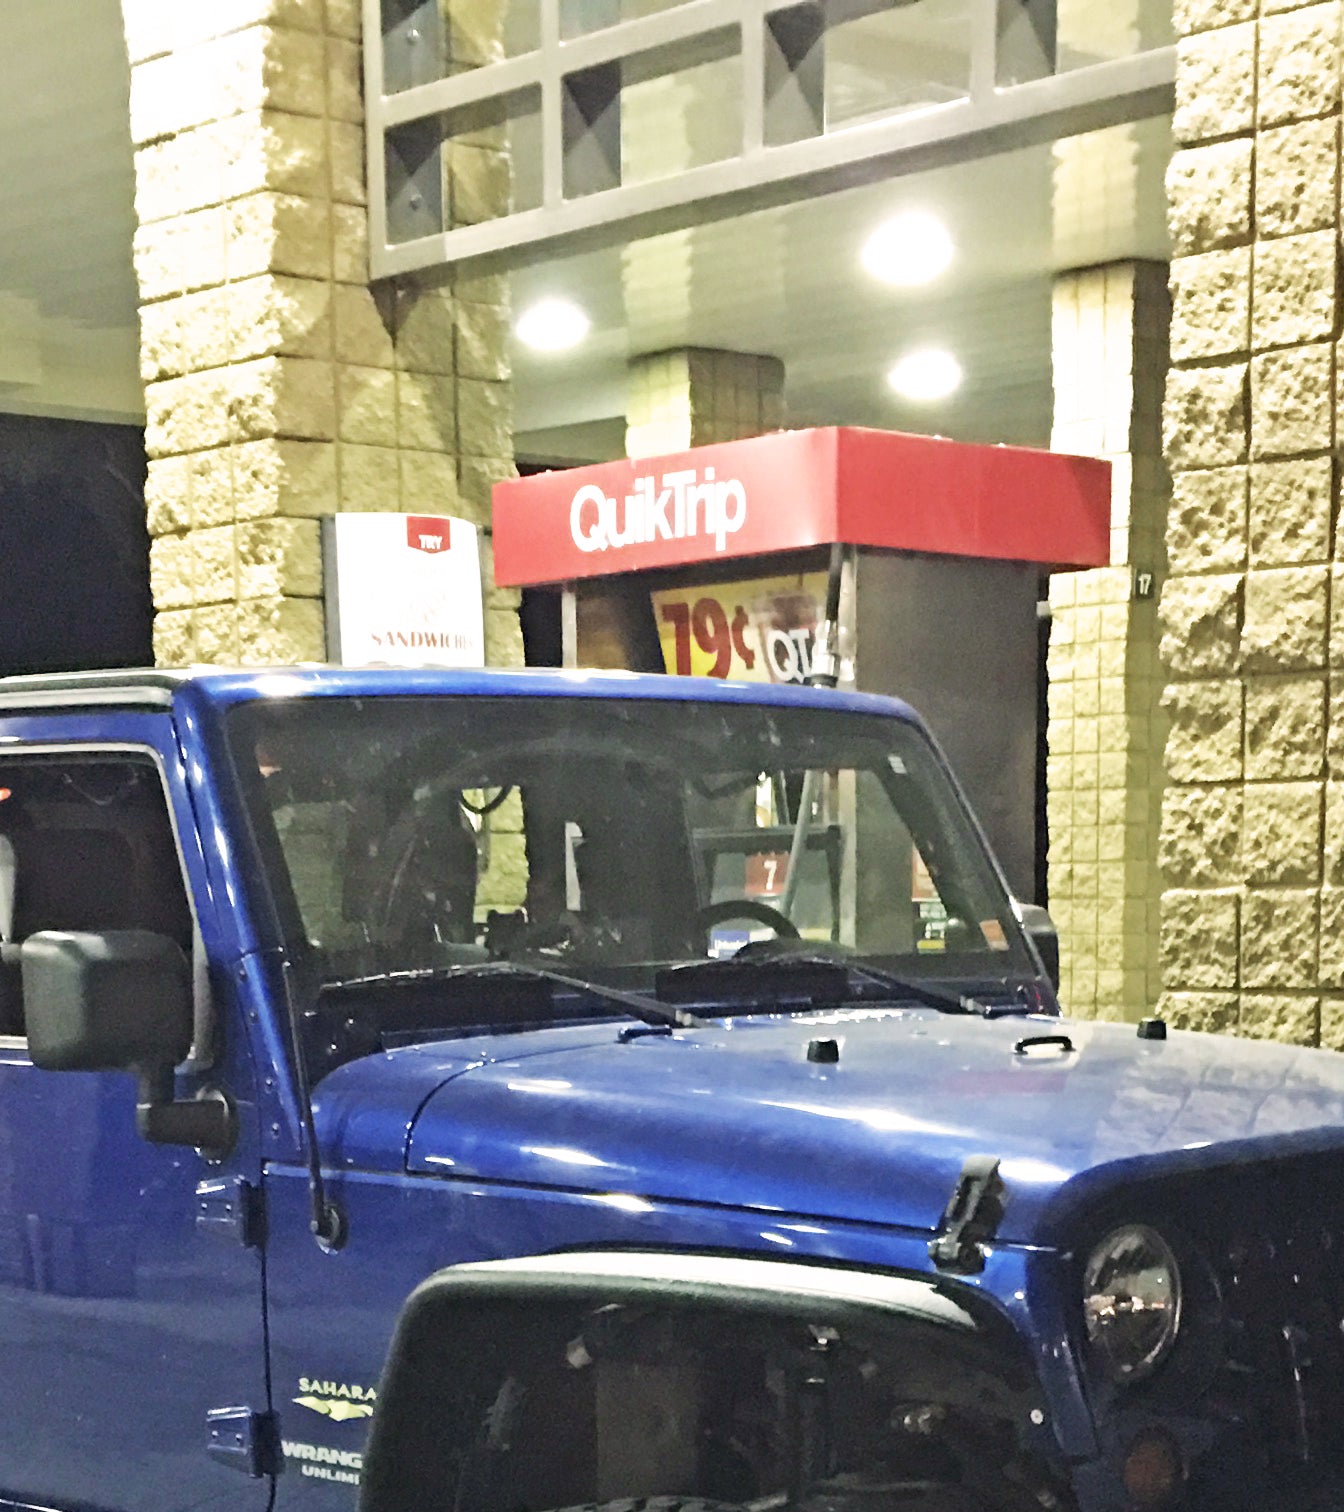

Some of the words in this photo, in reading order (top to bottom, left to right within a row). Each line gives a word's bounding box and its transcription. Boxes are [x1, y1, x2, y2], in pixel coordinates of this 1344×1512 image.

[569, 466, 747, 552] QuikTrip
[418, 534, 443, 550] TRY
[1138, 573, 1152, 595] 17
[763, 859, 778, 891] 7
[298, 1377, 377, 1401] SAHARA
